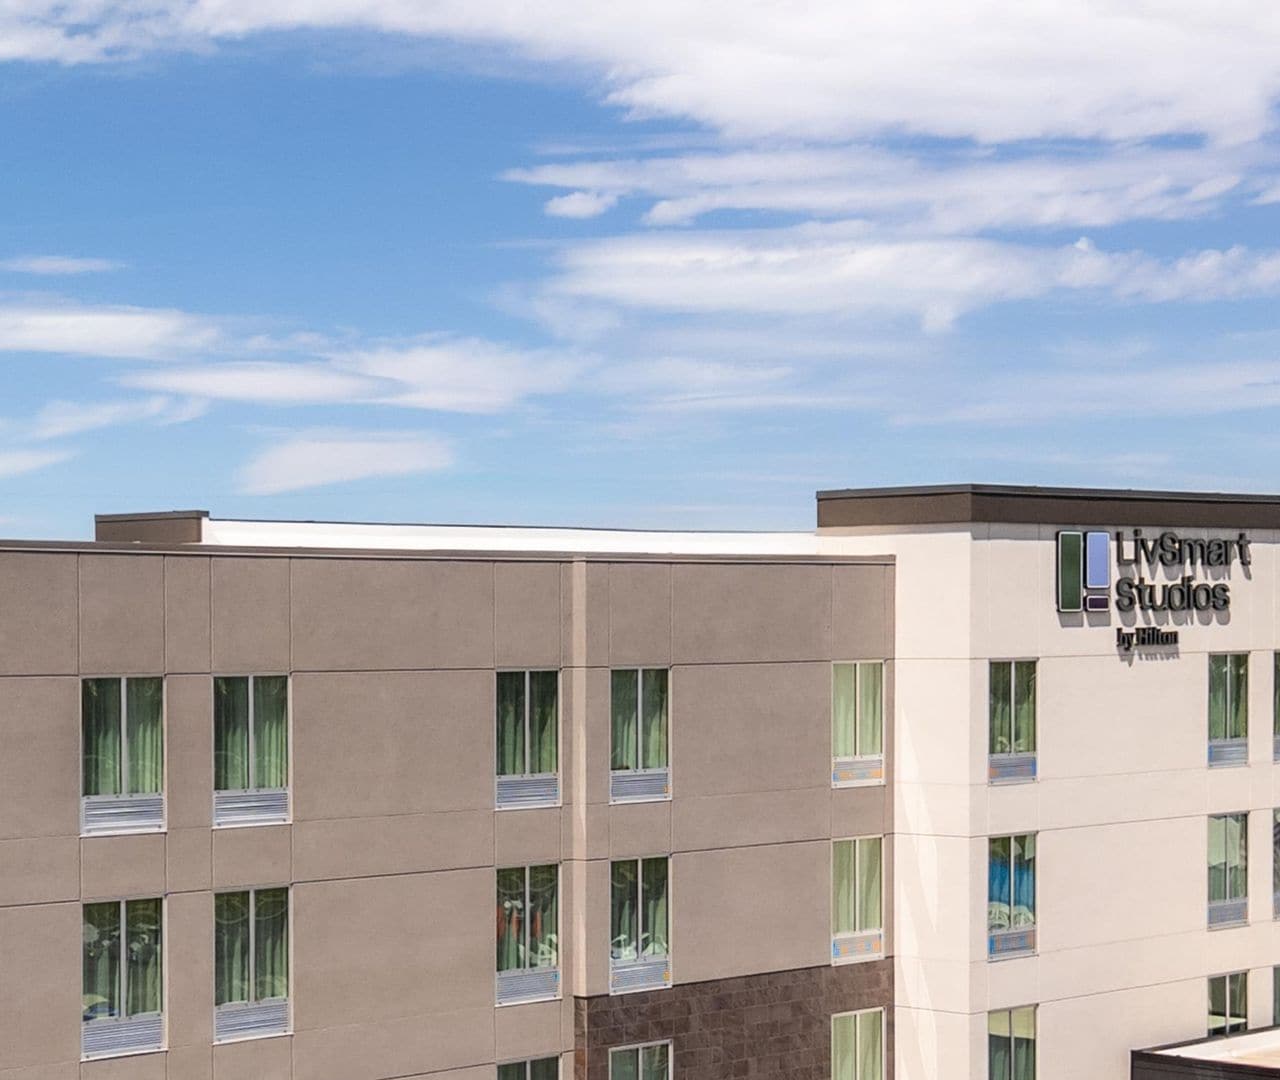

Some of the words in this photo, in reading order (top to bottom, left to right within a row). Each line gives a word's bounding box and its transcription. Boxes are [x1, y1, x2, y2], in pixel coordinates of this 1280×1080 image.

[1116, 529, 1252, 566] LivSmart
[1116, 576, 1230, 612] Studios
[1116, 628, 1134, 651] by
[1135, 627, 1179, 646] Hilton
